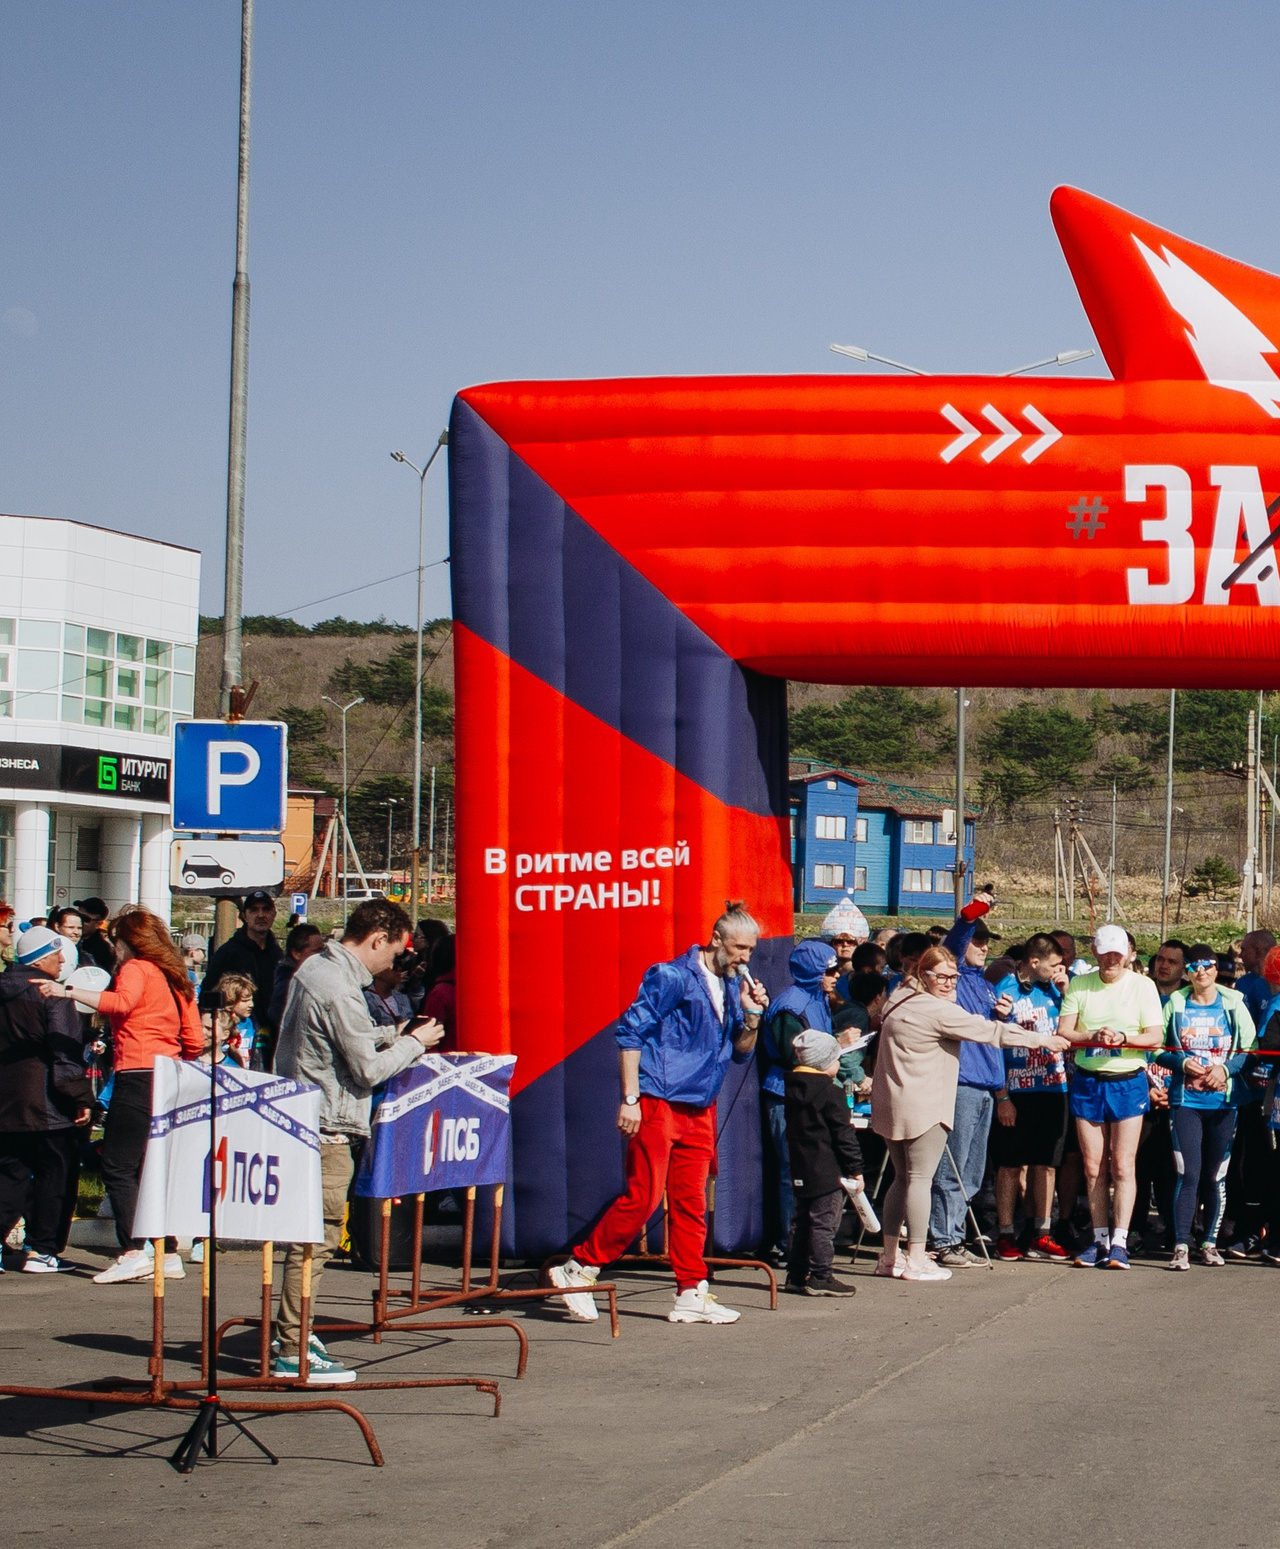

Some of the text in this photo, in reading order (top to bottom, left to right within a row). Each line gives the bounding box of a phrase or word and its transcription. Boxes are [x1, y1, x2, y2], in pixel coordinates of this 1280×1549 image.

[121, 758, 168, 779] ИТУРУП
[121, 779, 141, 792] БАНК
[208, 740, 261, 815] P
[484, 840, 690, 878] В ритме всей
[293, 895, 305, 913] P
[515, 879, 661, 912] СТРАНЫ!
[440, 1117, 481, 1163] ПСБ
[231, 1151, 280, 1206] ПСБ
